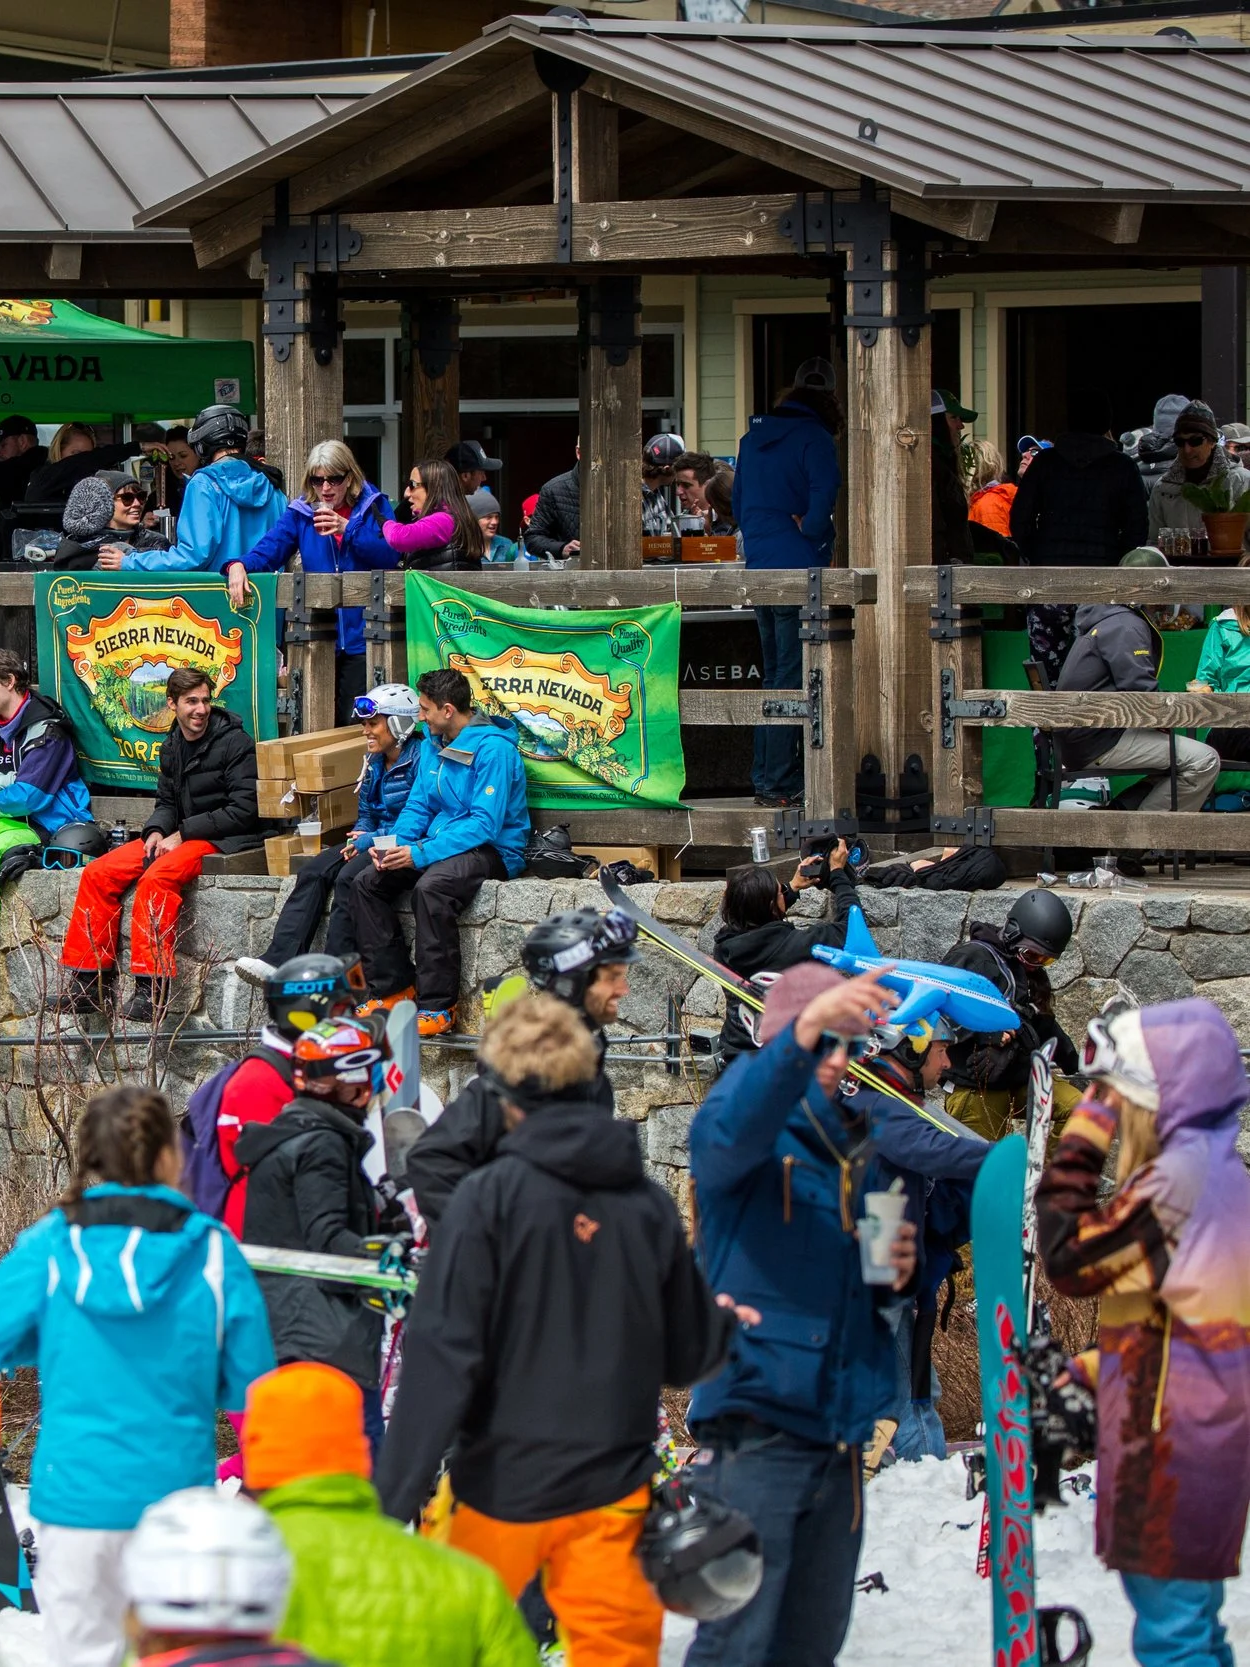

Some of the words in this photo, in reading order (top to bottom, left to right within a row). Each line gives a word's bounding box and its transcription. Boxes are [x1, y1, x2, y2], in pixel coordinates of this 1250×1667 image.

[442, 606, 467, 620] Purest
[441, 621, 487, 637] gredients
[619, 628, 639, 639] Finest
[95, 627, 150, 659] SIERRA
[153, 625, 217, 661] NEVADA
[611, 640, 645, 658] Quality
[683, 663, 761, 681] ASEBA
[480, 676, 533, 696] ERRA
[537, 678, 604, 716] NEVADA
[282, 979, 336, 995] SCOTT
